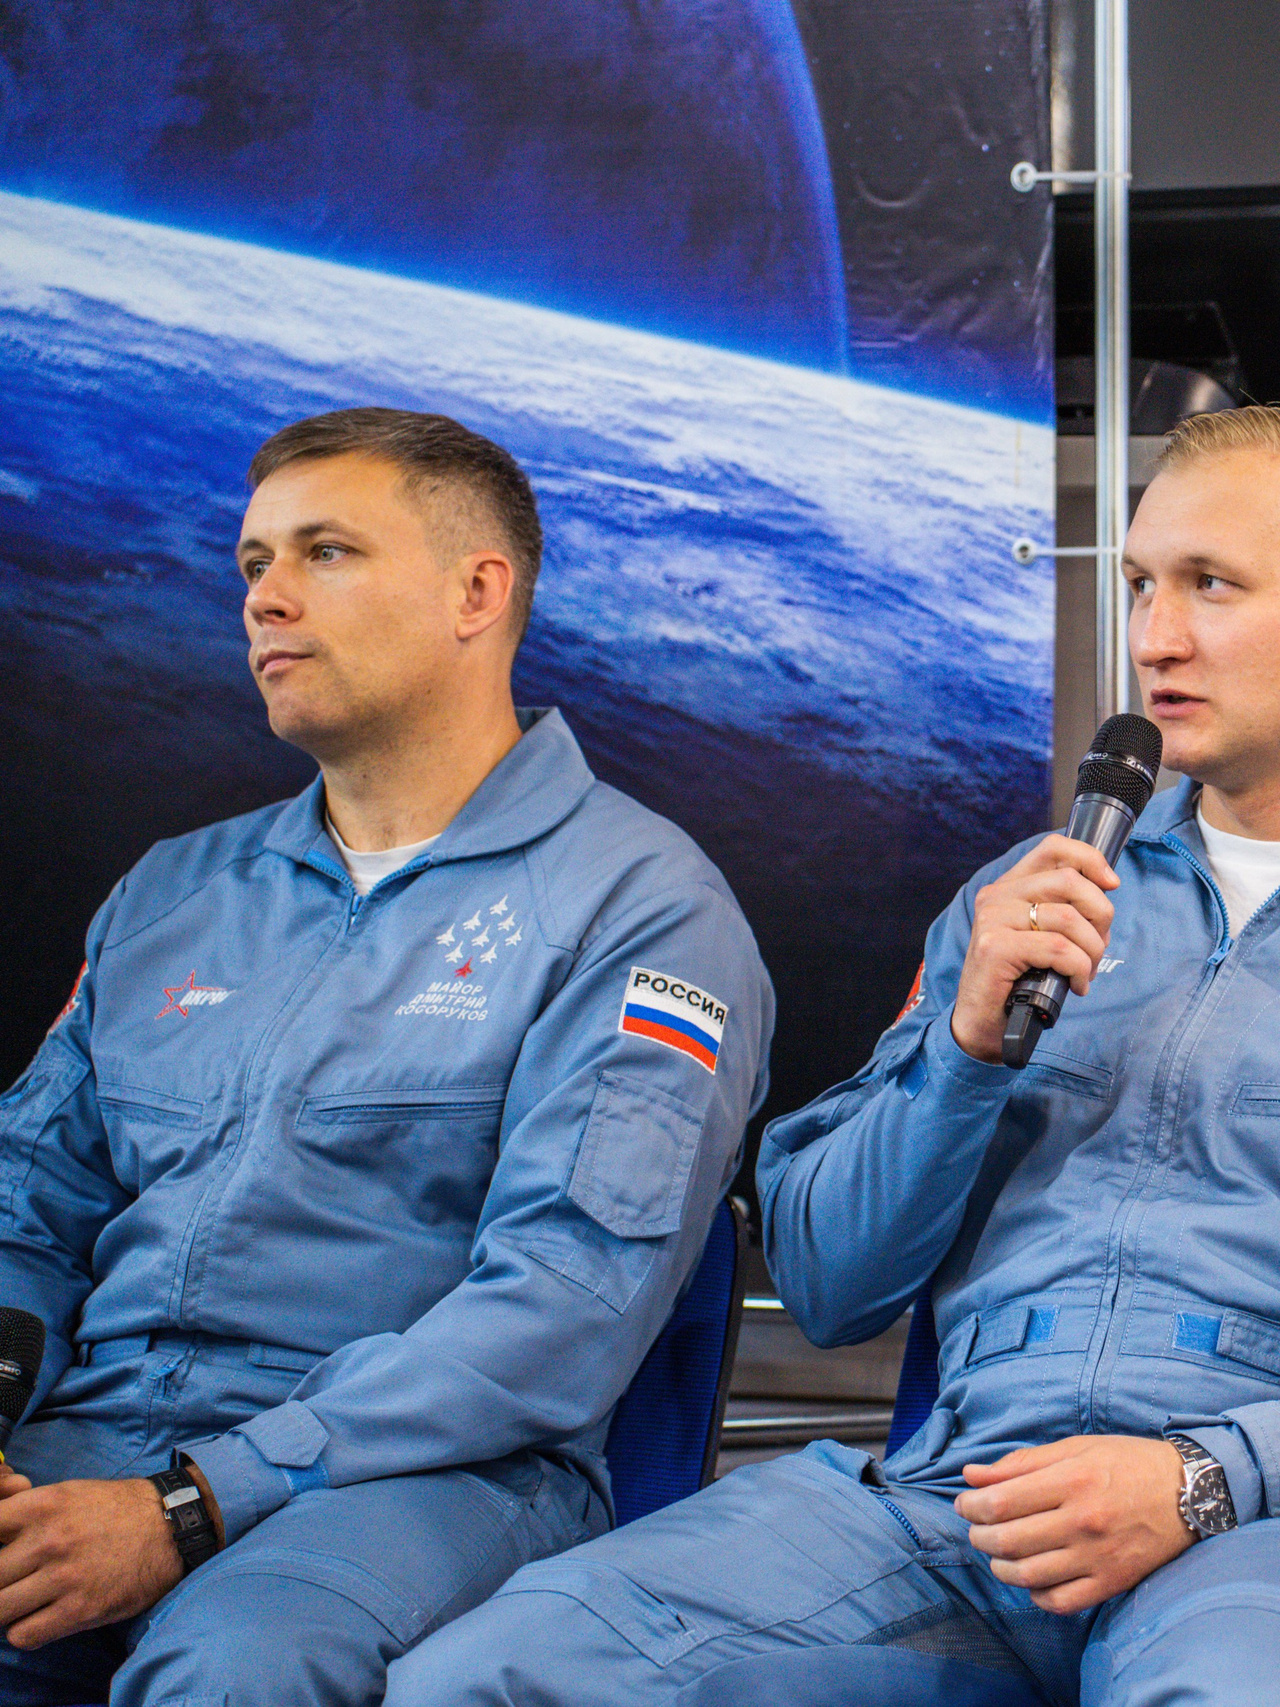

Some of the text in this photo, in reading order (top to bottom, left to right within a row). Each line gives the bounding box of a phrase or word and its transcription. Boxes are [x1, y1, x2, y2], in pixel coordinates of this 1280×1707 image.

[426, 980, 484, 996] МАЙОР
[408, 993, 487, 1009] ДМИТРИЙ
[633, 972, 726, 1025] РОССИЯ
[394, 1004, 489, 1022] КОСОРУКОВ
